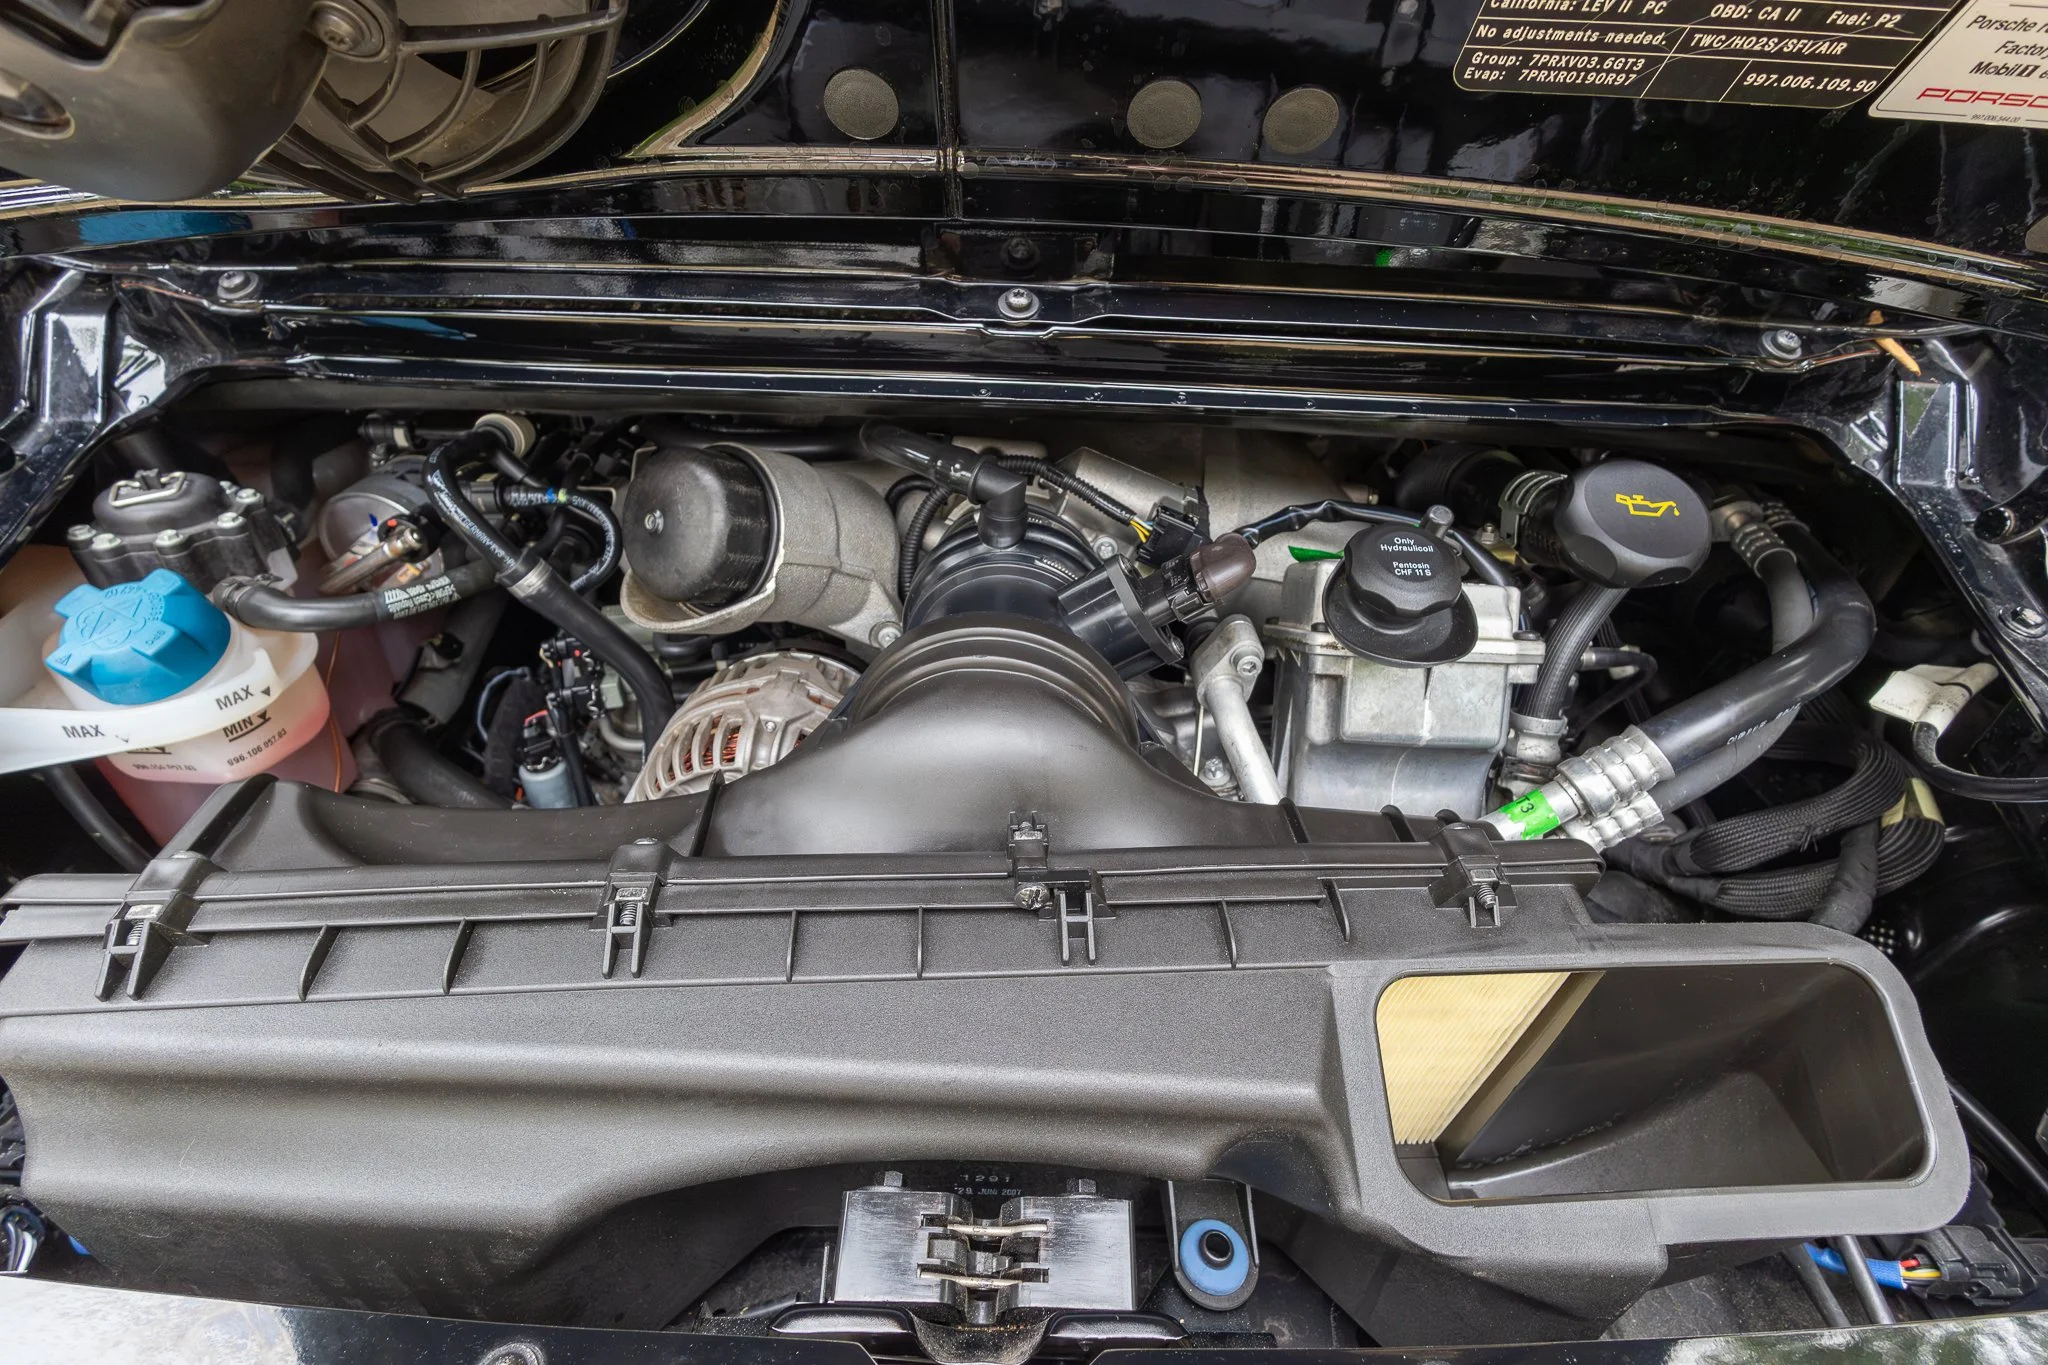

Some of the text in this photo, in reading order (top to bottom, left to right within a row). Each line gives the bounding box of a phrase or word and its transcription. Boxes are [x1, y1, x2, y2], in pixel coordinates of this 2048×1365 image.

[1581, 0, 1616, 12] LEV
[1641, 0, 1668, 15] PC
[1710, 3, 1753, 20] OBD:
[1758, 7, 1784, 21] CA
[1826, 10, 1872, 27] Fuel:
[1874, 13, 1902, 28] P2
[1966, 15, 2038, 32] Porsche
[1475, 24, 1848, 56] No adjustments needed. TWC/HO2S/SFI/AIR
[1471, 51, 1646, 72] Group: 7PRXV03.6GT3
[1464, 66, 1638, 86] Evap: 7PRXR0190R97
[1743, 73, 1878, 93] 997.006.109.90
[1380, 544, 1434, 552] Hydraulicoil
[1394, 537, 1414, 545] Only
[1392, 561, 1430, 569] Pentosin
[1394, 568, 1413, 576] CHF
[1414, 569, 1424, 577] 11
[215, 684, 254, 710] MAX
[61, 724, 105, 738] MAX
[222, 716, 254, 738] MIN
